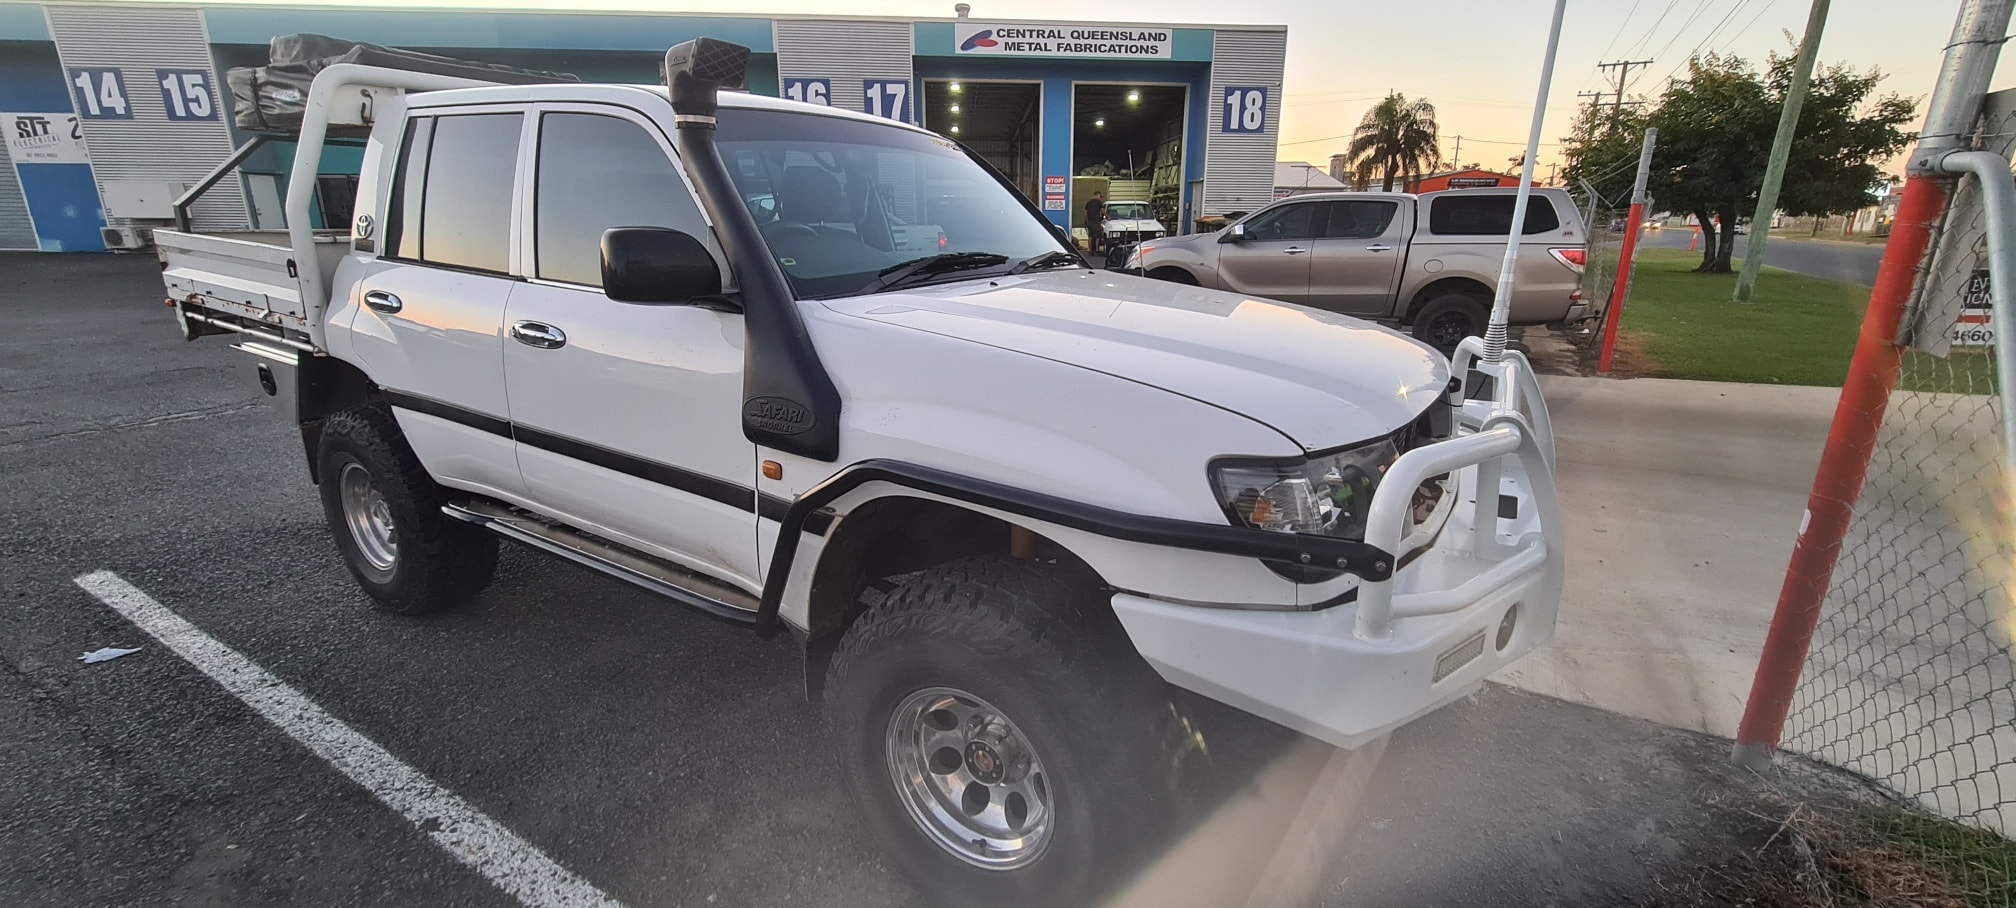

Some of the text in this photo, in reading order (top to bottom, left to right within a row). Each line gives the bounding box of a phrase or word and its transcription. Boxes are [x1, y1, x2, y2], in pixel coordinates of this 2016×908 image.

[996, 29, 1168, 42] CENTRAL QUEENSLAND
[1004, 41, 1159, 55] METAL FABRICATIONS
[75, 71, 126, 115] 14
[162, 73, 211, 117] 15
[866, 83, 906, 121] 17
[1227, 90, 1263, 130] 18
[13, 134, 61, 148] ELECTRICAL
[750, 399, 805, 423] SAFARI
